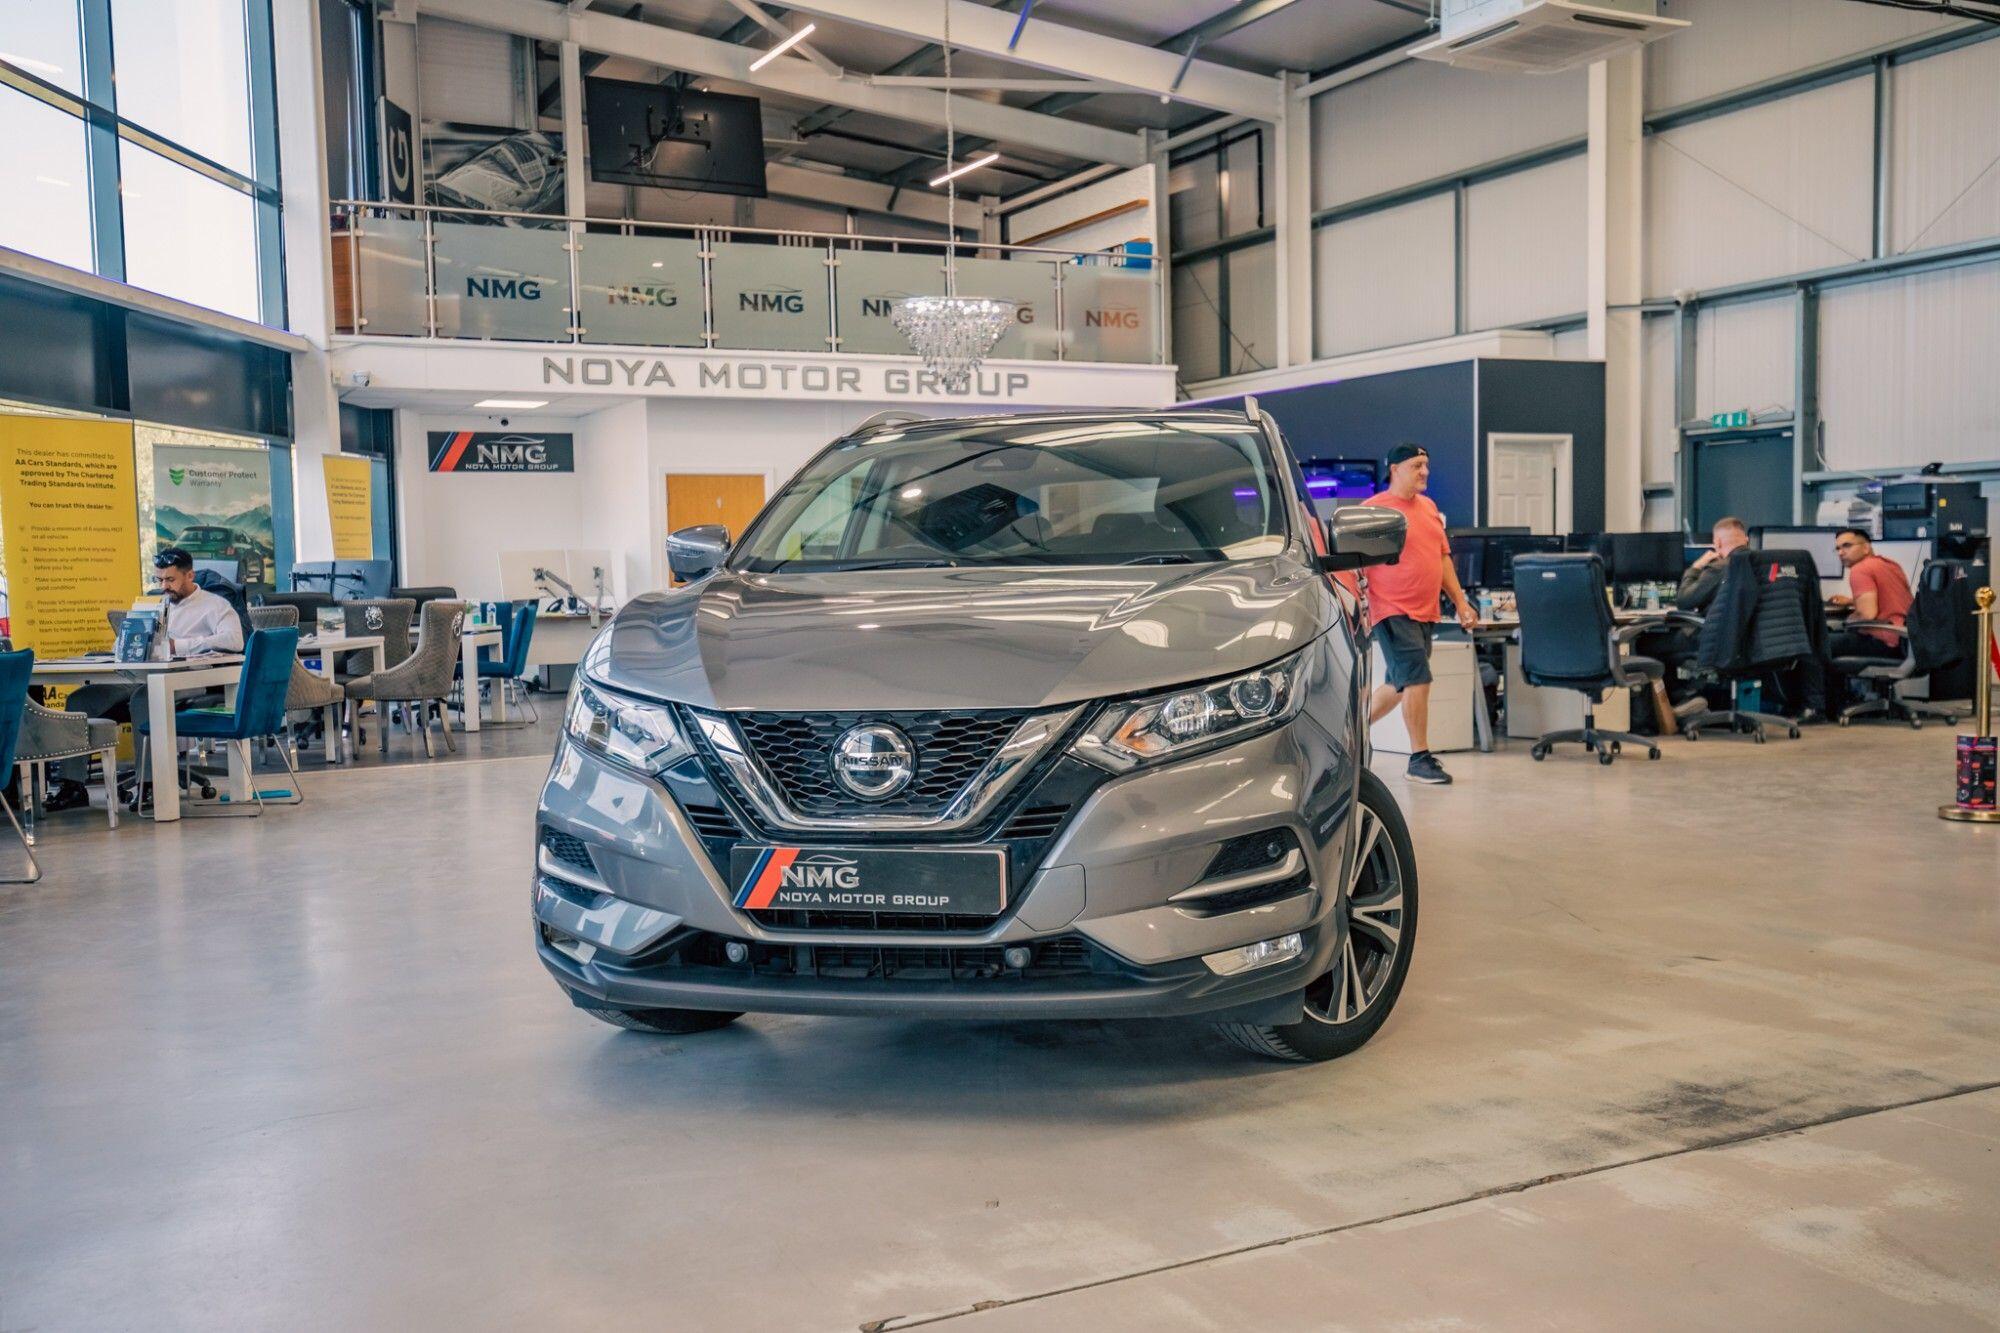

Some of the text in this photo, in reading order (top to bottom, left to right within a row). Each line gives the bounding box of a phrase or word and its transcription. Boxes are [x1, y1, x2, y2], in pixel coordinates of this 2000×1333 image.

[467, 277, 541, 300] NMG
[608, 285, 677, 307] NMG
[739, 293, 804, 313] NMG
[1086, 310, 1139, 329] NMG
[543, 357, 675, 387] NOYA
[700, 362, 861, 392] MOTOR
[17, 448, 32, 456] This
[33, 449, 55, 457] dealer
[71, 452, 106, 460] committed
[477, 444, 547, 464] NMG
[20, 470, 54, 478] approved
[189, 469, 257, 479] Customer Protect
[20, 479, 47, 488] Trading
[48, 480, 85, 488] Standards
[190, 480, 222, 488] Warranty
[842, 755, 905, 767] NISSAN
[780, 865, 860, 889] NMG
[780, 892, 949, 906] NOYA MOTOR GROUP
